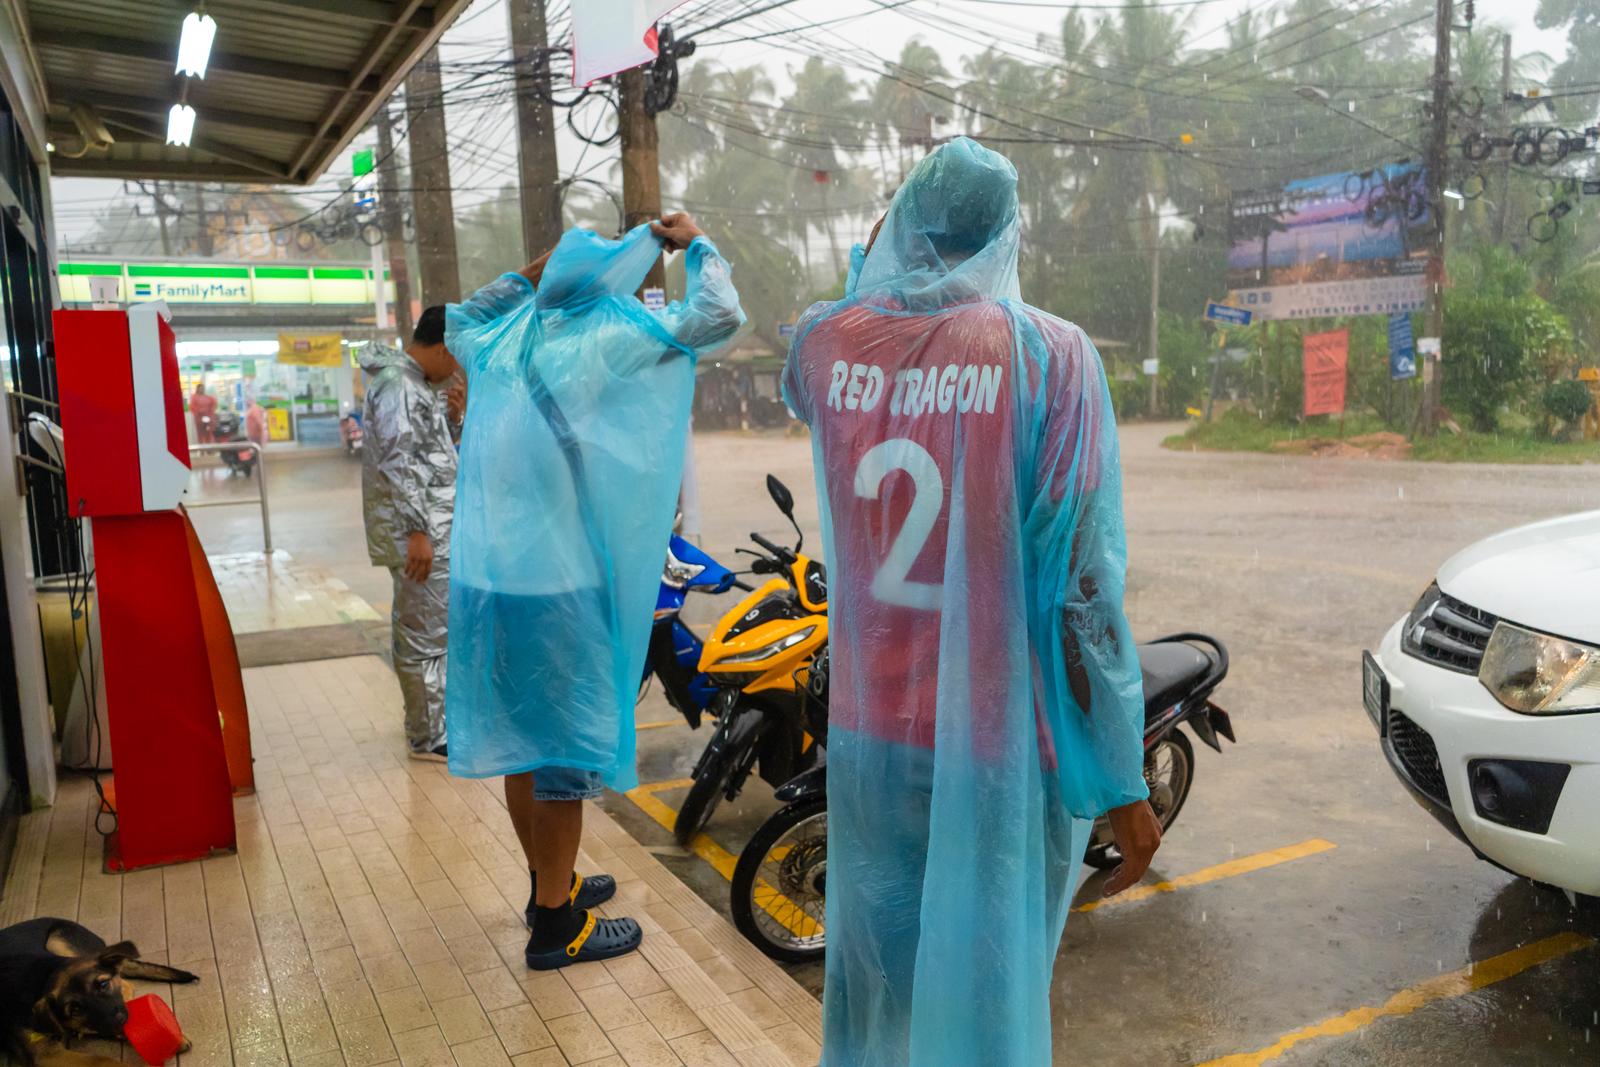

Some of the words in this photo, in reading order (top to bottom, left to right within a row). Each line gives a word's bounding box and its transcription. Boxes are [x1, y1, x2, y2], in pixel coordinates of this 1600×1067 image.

[156, 283, 246, 299] FamilyMart
[827, 360, 885, 413] RED
[853, 437, 945, 612] 2
